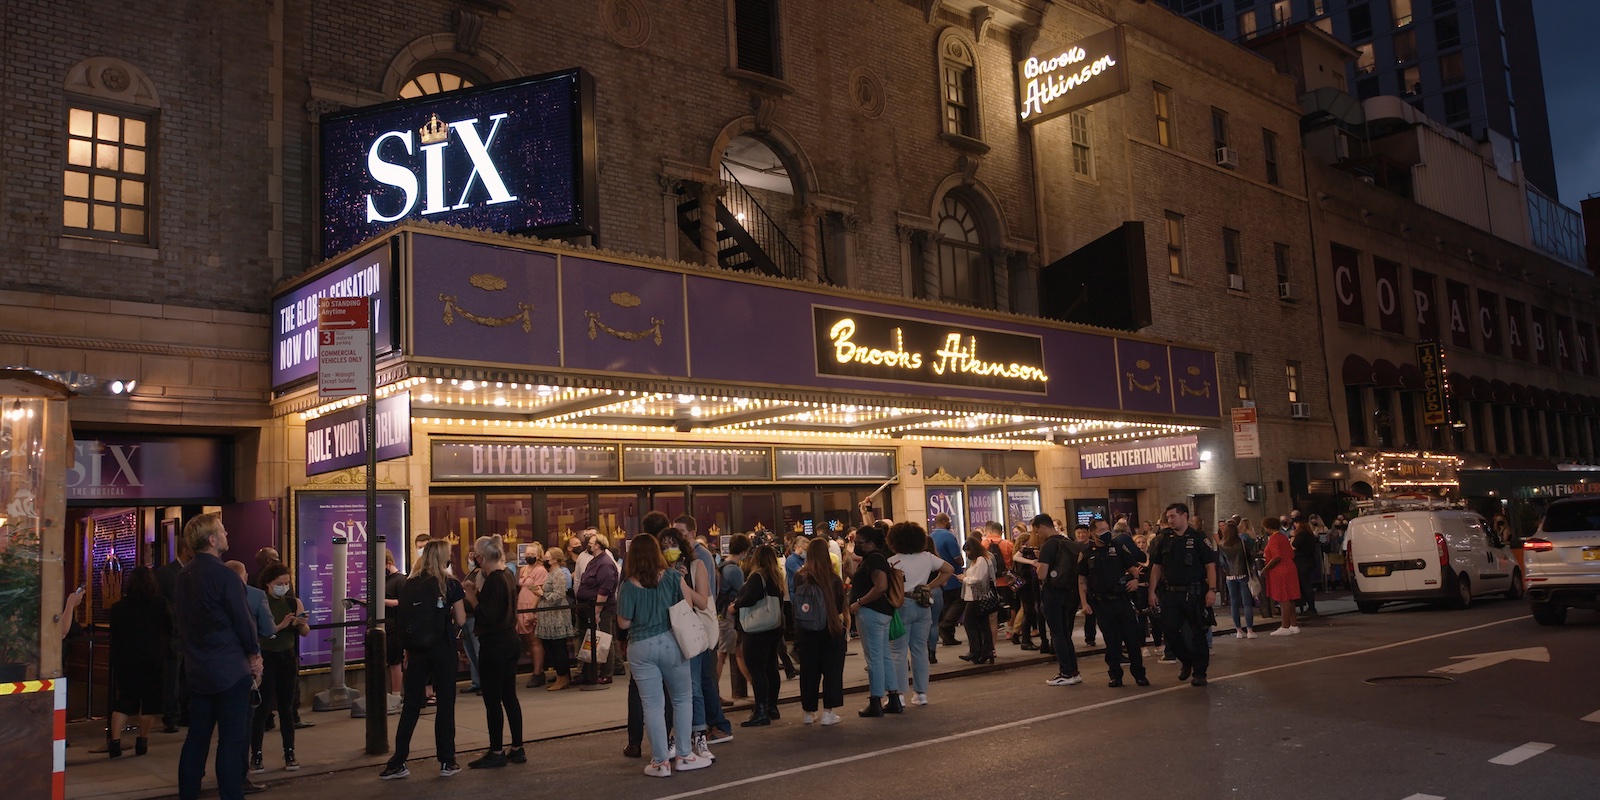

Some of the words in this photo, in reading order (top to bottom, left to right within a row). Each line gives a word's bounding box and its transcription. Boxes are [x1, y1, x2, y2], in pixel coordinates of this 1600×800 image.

[1024, 46, 1086, 79] Brooks
[1020, 54, 1116, 119] Atkinson
[366, 113, 518, 224] SIX
[280, 303, 295, 334] THE
[297, 291, 326, 328] GLOB
[321, 308, 346, 316] Anytime
[331, 299, 361, 307] STANDING
[280, 332, 301, 370] NOW
[304, 325, 318, 362] ON
[321, 349, 357, 357] COMMERCIAL
[322, 331, 331, 345] 3
[829, 318, 922, 369] Brooks
[933, 332, 1048, 382] Atkinson
[308, 427, 332, 465] RULE
[333, 419, 360, 458] YOUR
[472, 445, 577, 475] DIVORCED
[654, 450, 740, 475] BEHEADED
[797, 452, 871, 476] BROADWAY
[72, 487, 86, 496] THE
[90, 487, 125, 496] MUSICAL
[930, 494, 956, 516] SIX
